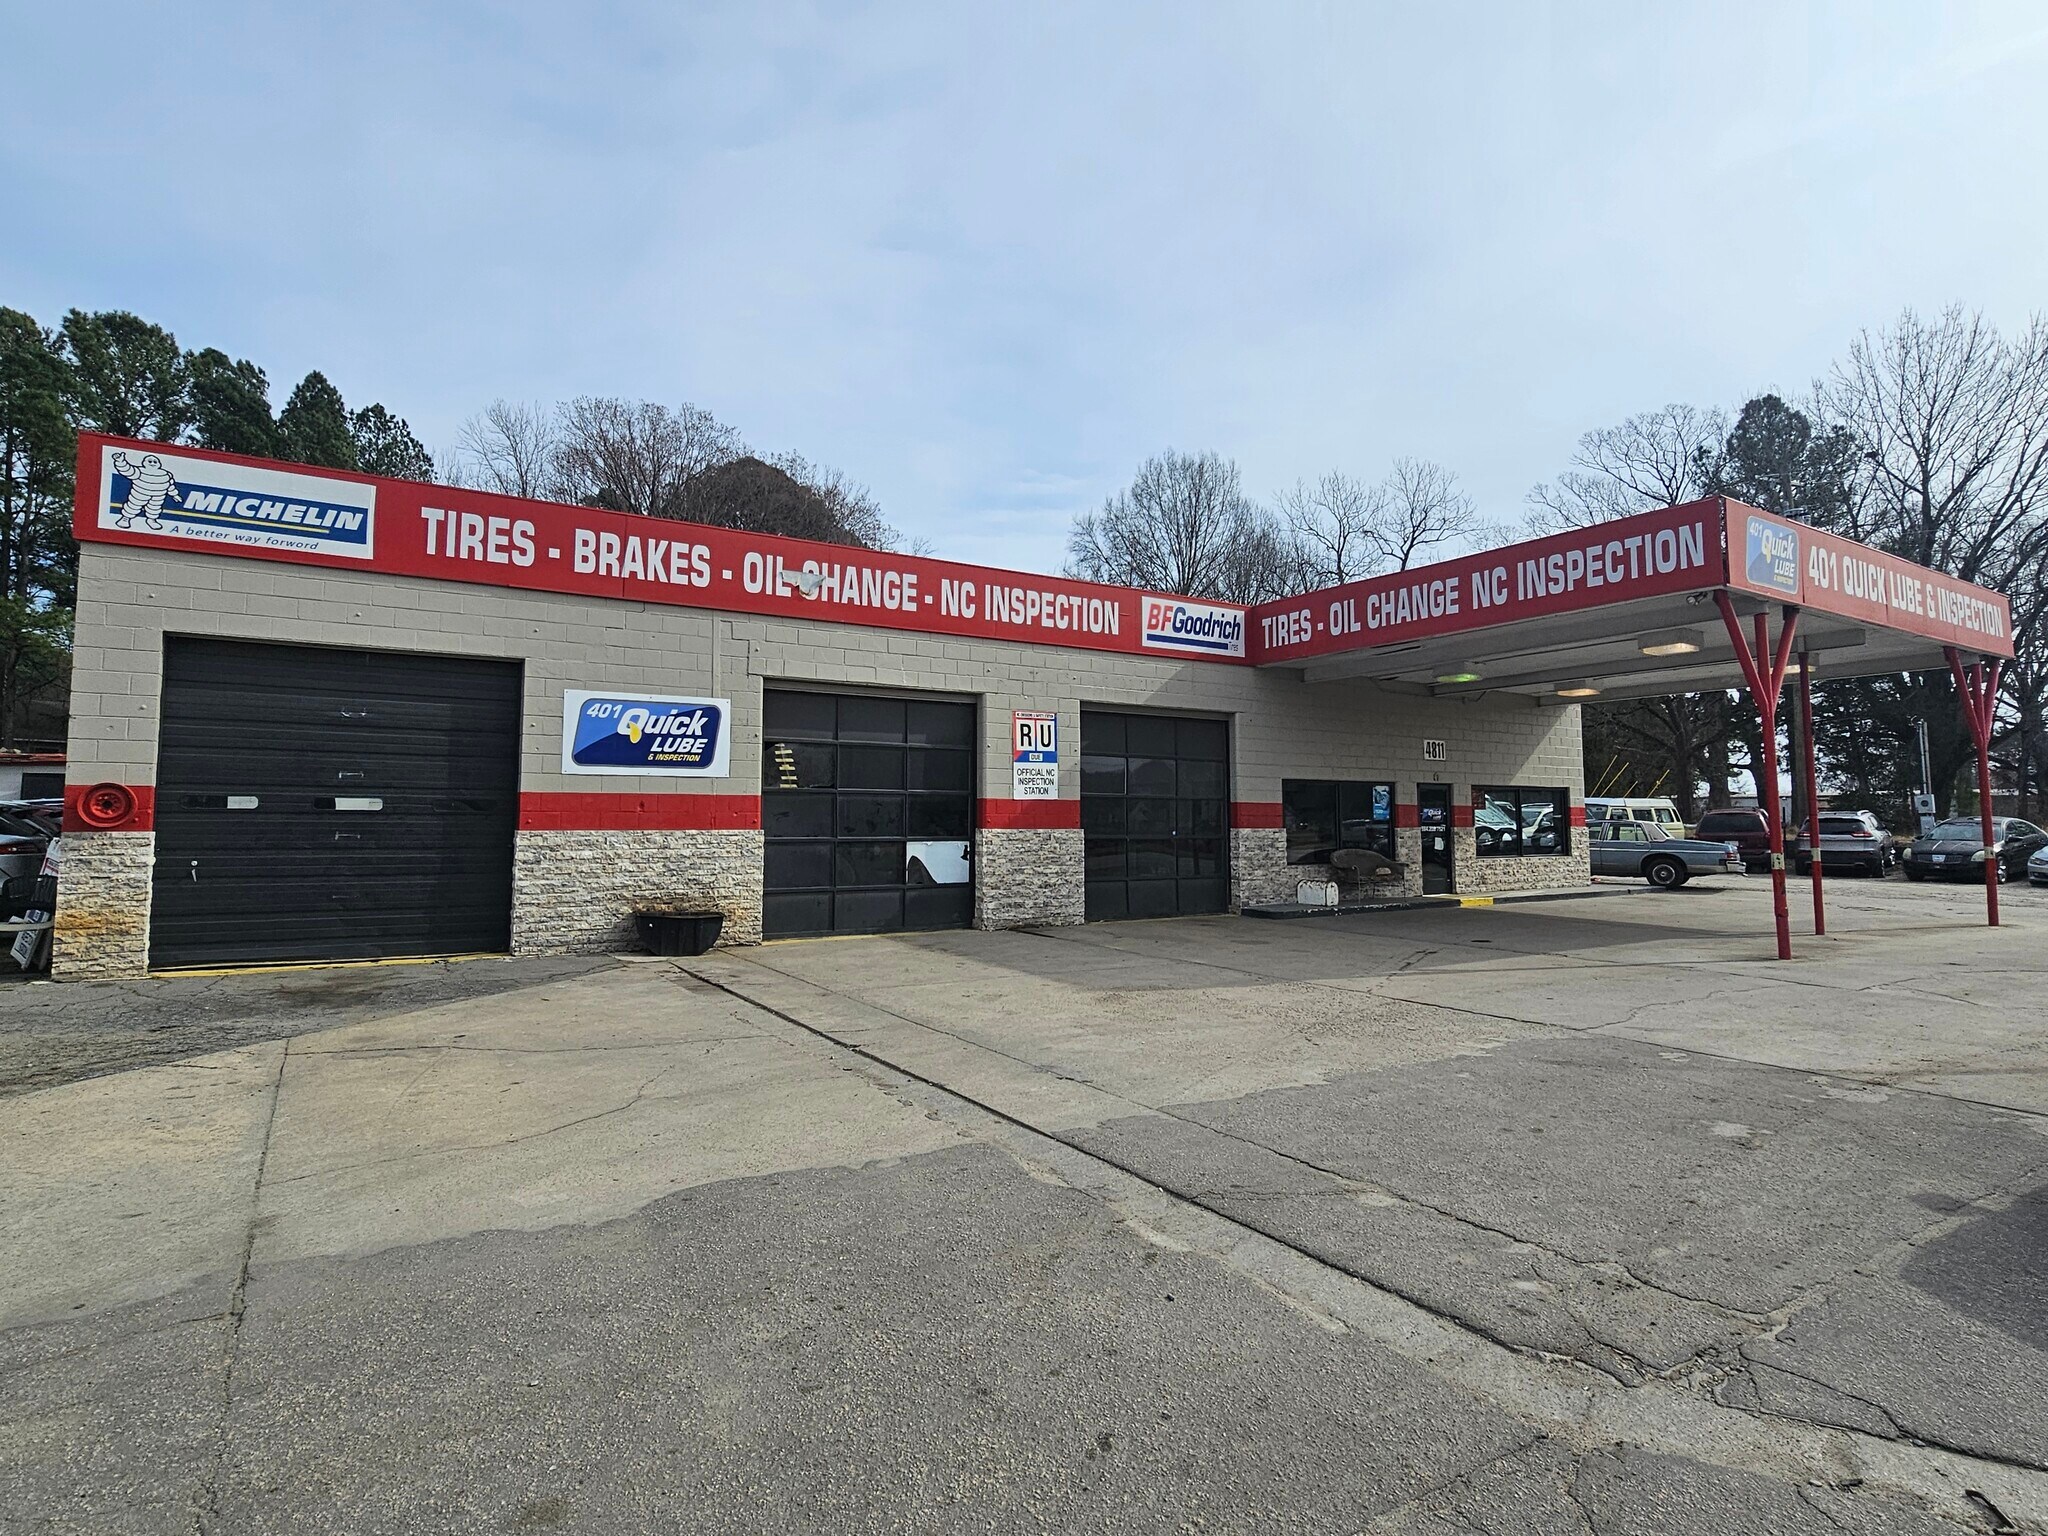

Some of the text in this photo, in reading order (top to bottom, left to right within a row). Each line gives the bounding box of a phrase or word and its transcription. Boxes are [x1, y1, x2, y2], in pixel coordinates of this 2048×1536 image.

[183, 491, 364, 531] MICHELIN
[170, 525, 179, 533] A
[186, 527, 230, 539] better
[235, 534, 261, 544] way
[1750, 522, 1794, 563] 401 Quick
[421, 506, 536, 567] TIRES
[574, 528, 711, 588] BRAKES
[743, 551, 792, 597] OIL
[941, 578, 976, 619] NC
[985, 584, 1120, 636] INSPECTION
[1775, 559, 1795, 577] LUBE
[1261, 611, 1312, 649] TIRES
[1329, 599, 1361, 636] OIL
[1367, 577, 1459, 630] CHANGE
[1472, 566, 1508, 609] NC
[1517, 522, 1705, 601] INSPECTION
[1809, 546, 2004, 638] 401 QUICK LUBE & INSPECTION
[1147, 603, 1241, 640] BFGoodrich
[586, 703, 709, 744] 401 Quick
[650, 737, 708, 753] LUBE
[1426, 741, 1445, 759] 4811
[656, 753, 701, 762] INSPECTION
[1017, 768, 1055, 777] OFFICIAL NC
[1018, 777, 1055, 786] INSPECTION
[1024, 787, 1049, 795] STATION
